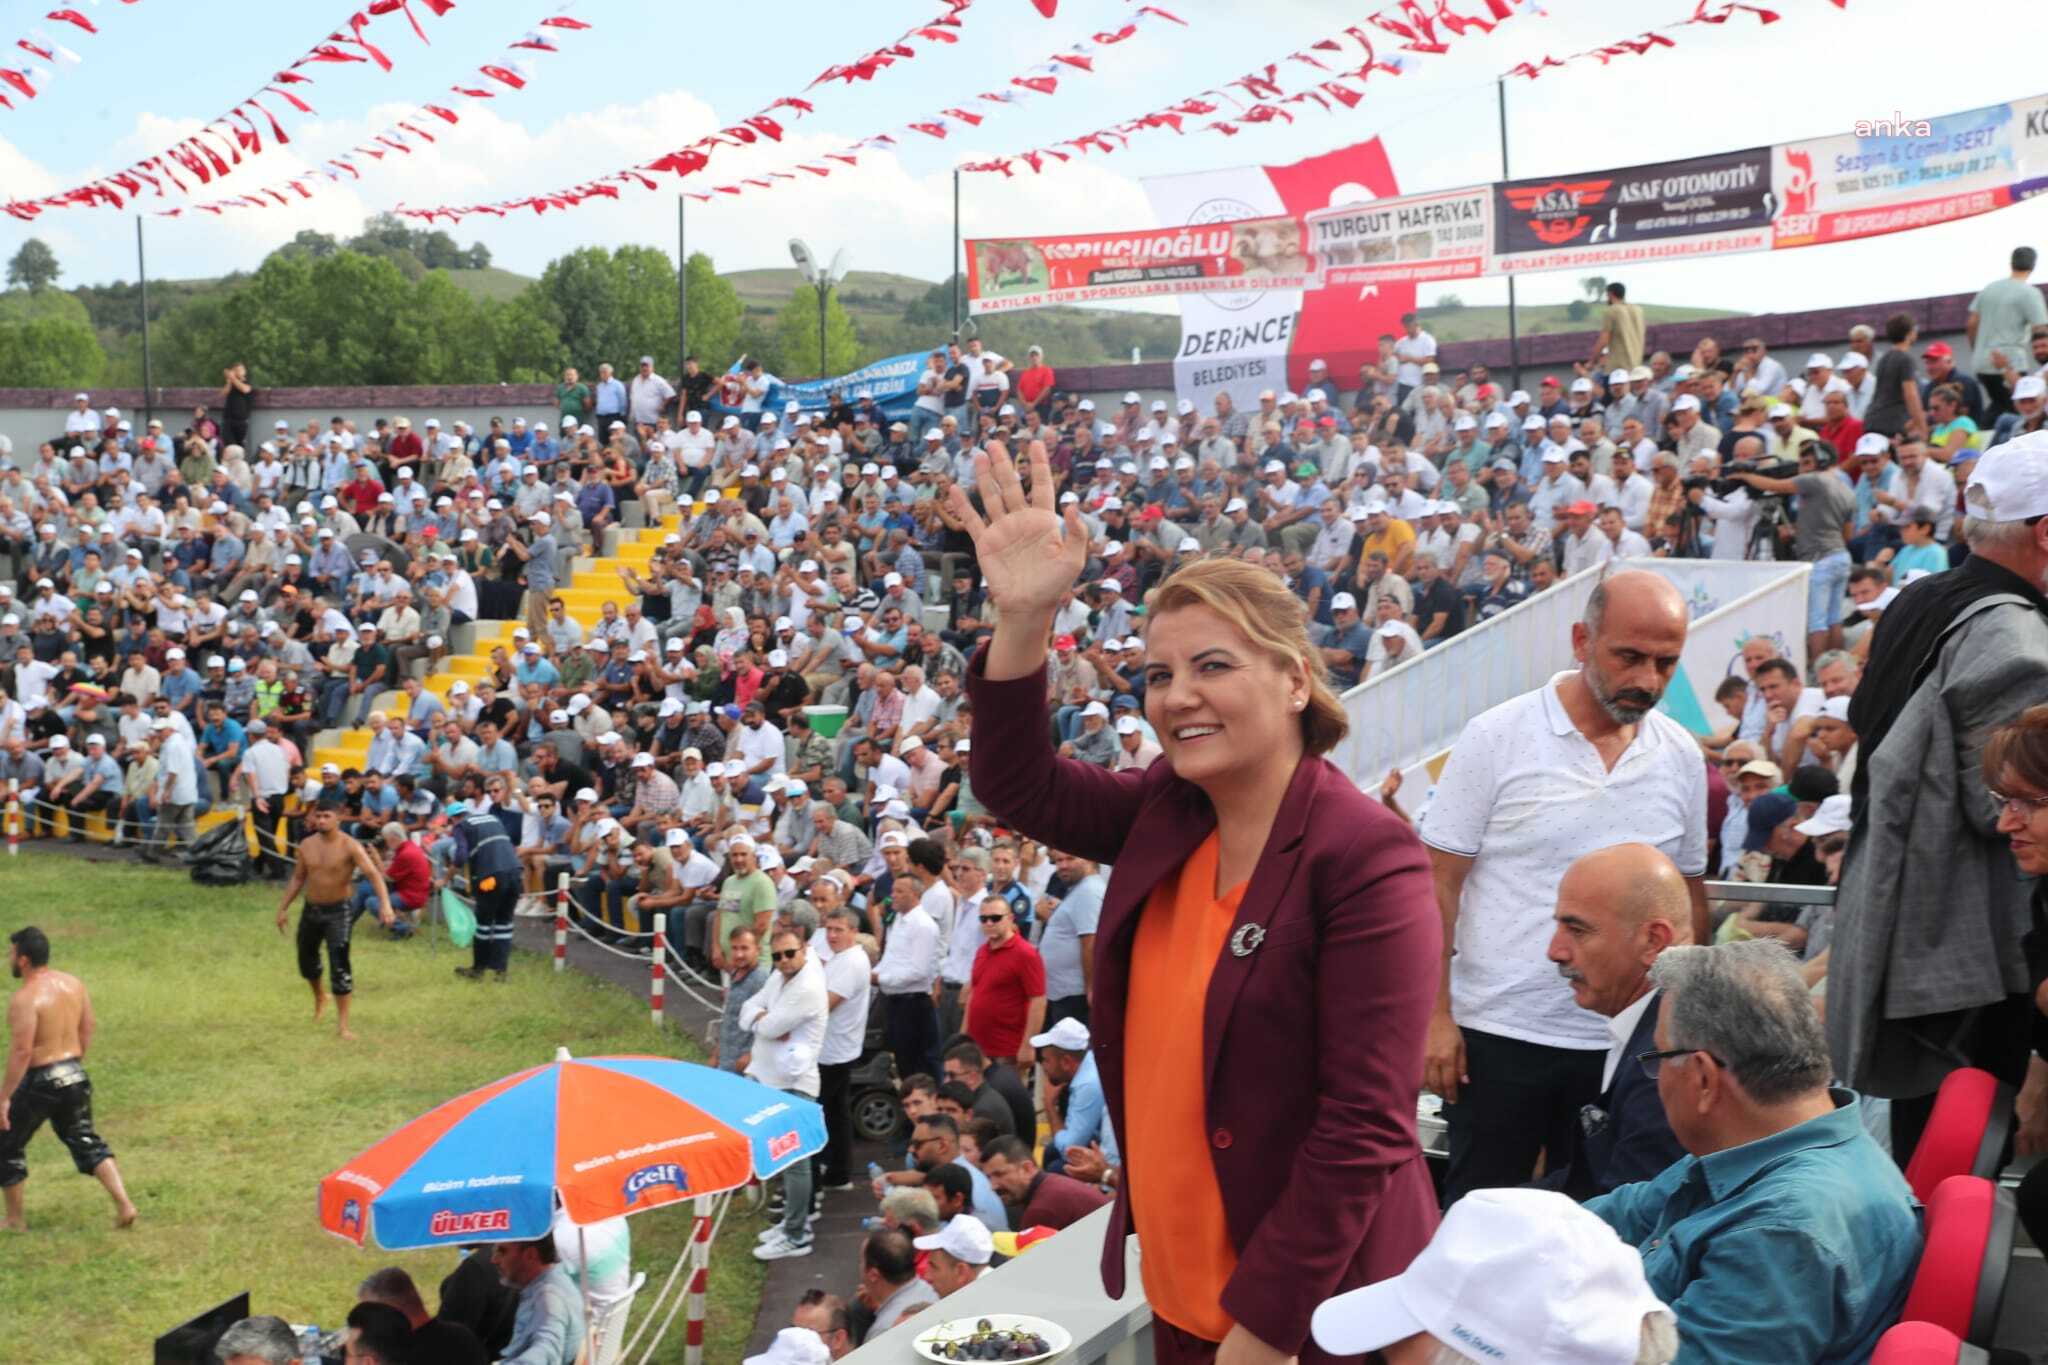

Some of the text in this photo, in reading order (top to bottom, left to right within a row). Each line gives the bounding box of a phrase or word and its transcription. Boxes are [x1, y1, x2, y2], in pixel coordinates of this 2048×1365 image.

[1952, 126, 1996, 151] SERT
[1618, 164, 1760, 203] ASAF OTOMOTİV
[1532, 189, 1584, 214] ASAF
[1318, 199, 1482, 239] TURGUT HAFRİYAT
[981, 294, 1041, 310] KATILAN
[1047, 290, 1076, 303] TÜM
[1082, 283, 1171, 300] SPORCULARA
[1183, 315, 1291, 357] DERİNCE
[1193, 360, 1267, 387] BELEDİYESİ
[431, 1209, 510, 1236] ÜLKER
